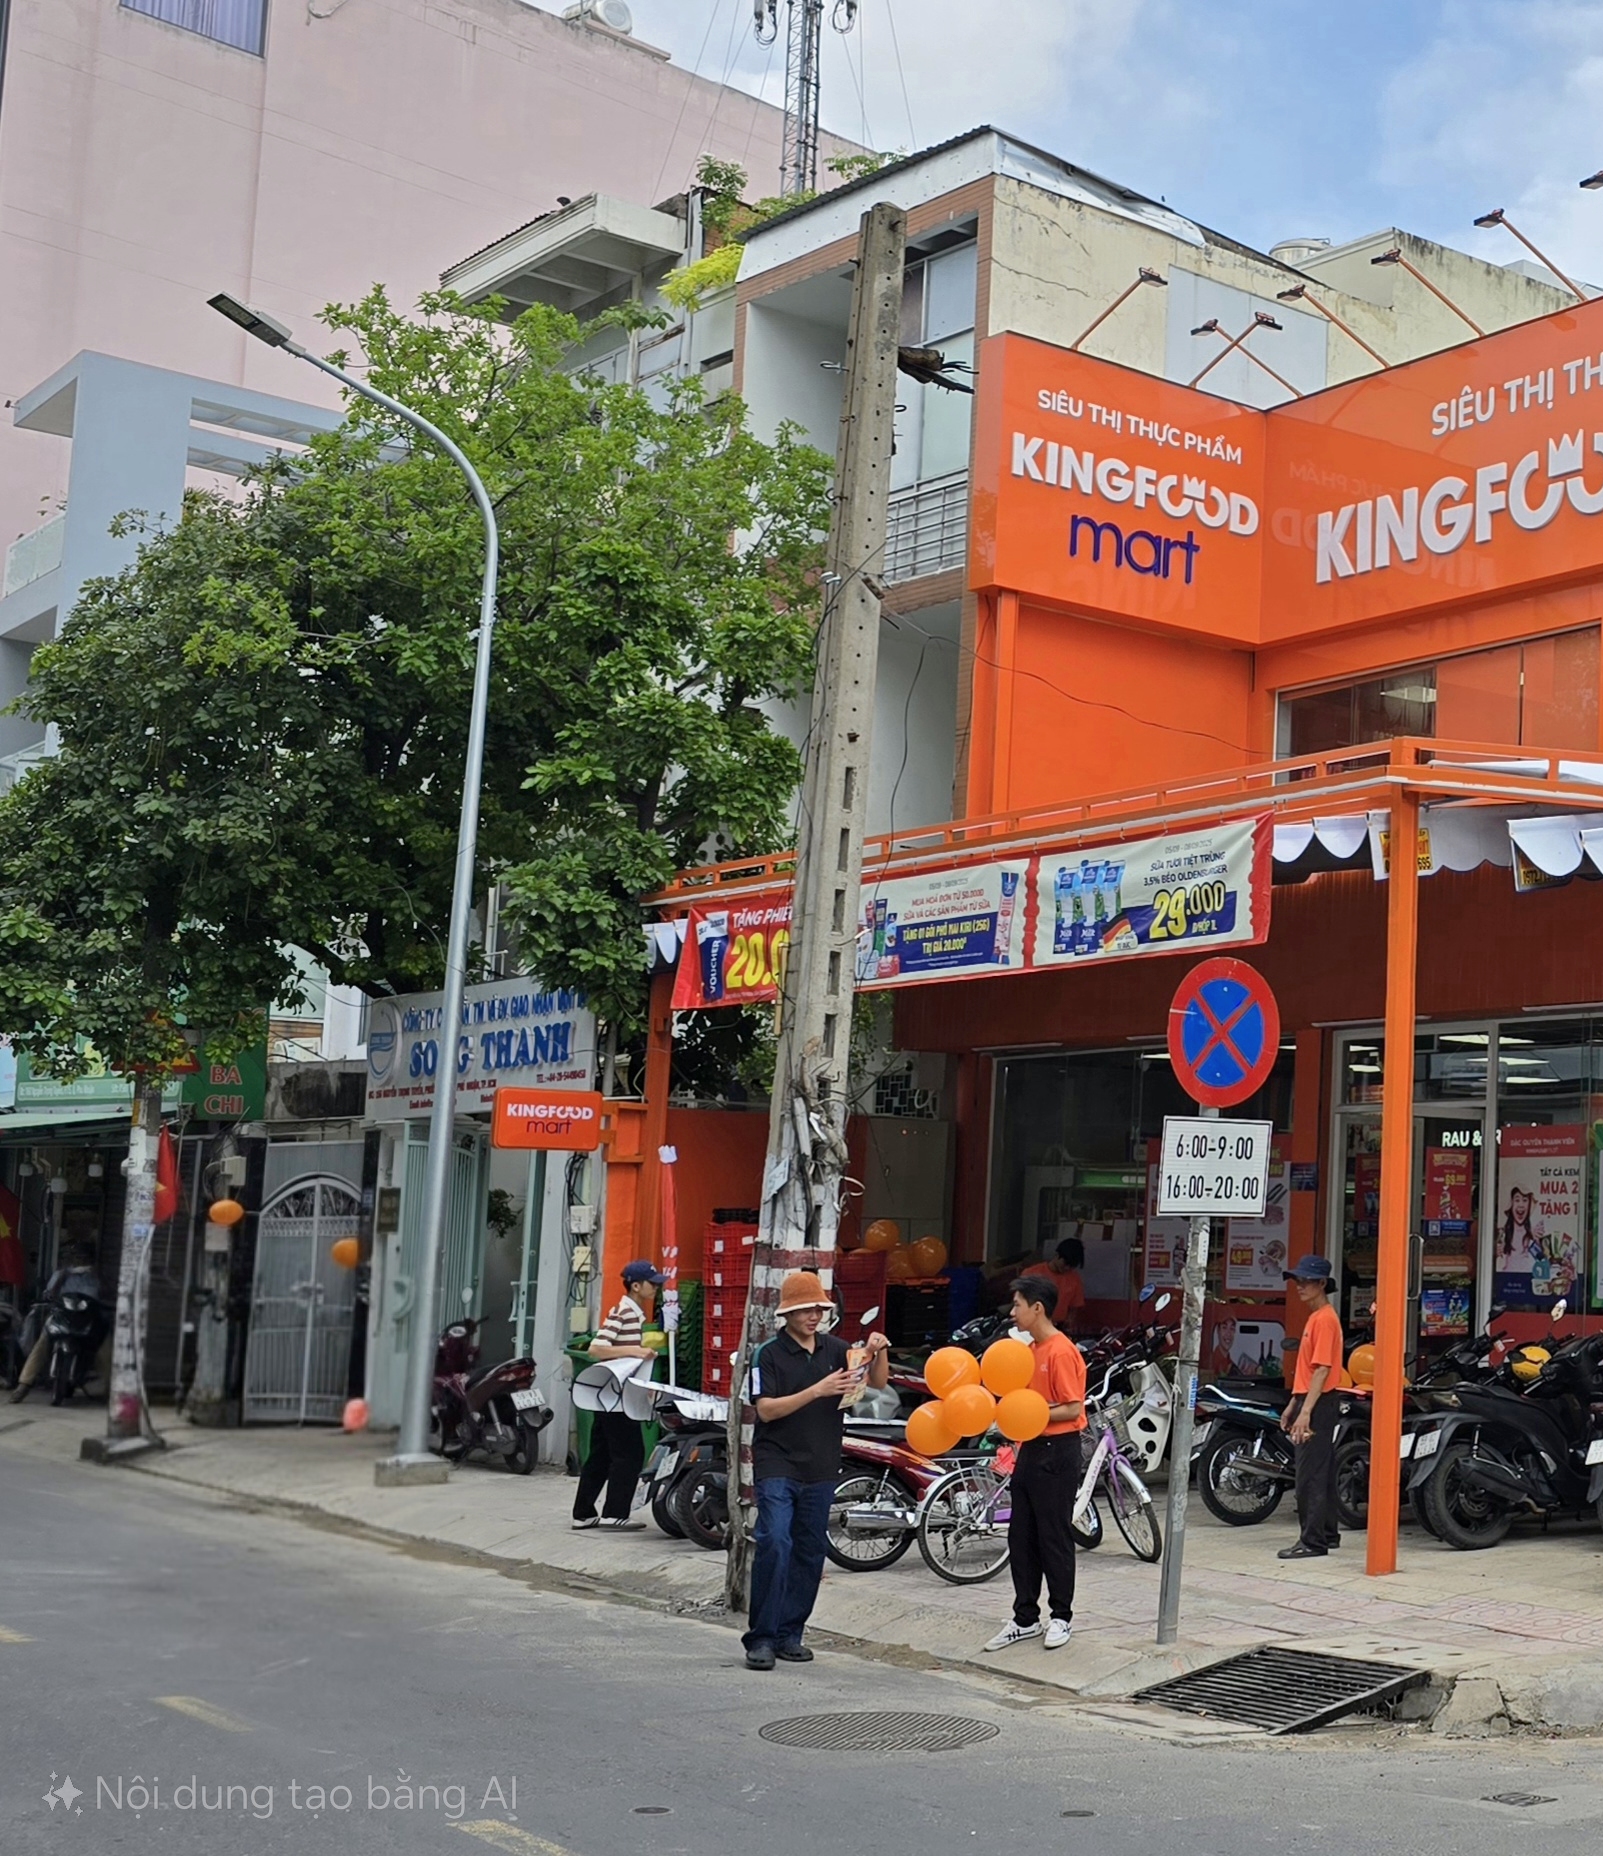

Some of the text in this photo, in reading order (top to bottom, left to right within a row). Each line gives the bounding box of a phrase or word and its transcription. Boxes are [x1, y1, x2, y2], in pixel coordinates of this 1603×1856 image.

[1431, 373, 1496, 436] SIÊU
[1503, 362, 1557, 411] THỊ
[1037, 387, 1243, 466] SIÊU THỊ THỰC PHẨM
[1010, 431, 1260, 537] KINGFOOD
[1069, 512, 1201, 584] mart
[1162, 872, 1177, 884] BÉO
[732, 907, 762, 932] TẶNG
[1149, 880, 1227, 940] 29.000
[709, 940, 721, 994] VOUCHER
[726, 929, 790, 989] 20.0
[409, 1020, 576, 1078] SOG THANH
[209, 1065, 243, 1085] BA
[204, 1094, 244, 1116] CHI
[506, 1103, 594, 1121] KINGFOOD
[526, 1117, 573, 1135] mart
[1442, 1129, 1483, 1148] RAU &
[1176, 1134, 1254, 1160] 6:00-9:00
[1540, 1165, 1580, 1177] TẤT CẢ KEM
[1167, 1175, 1260, 1200] 16:00-20:00
[1540, 1180, 1579, 1195] MUA 2
[1539, 1199, 1571, 1219] TẶNG
